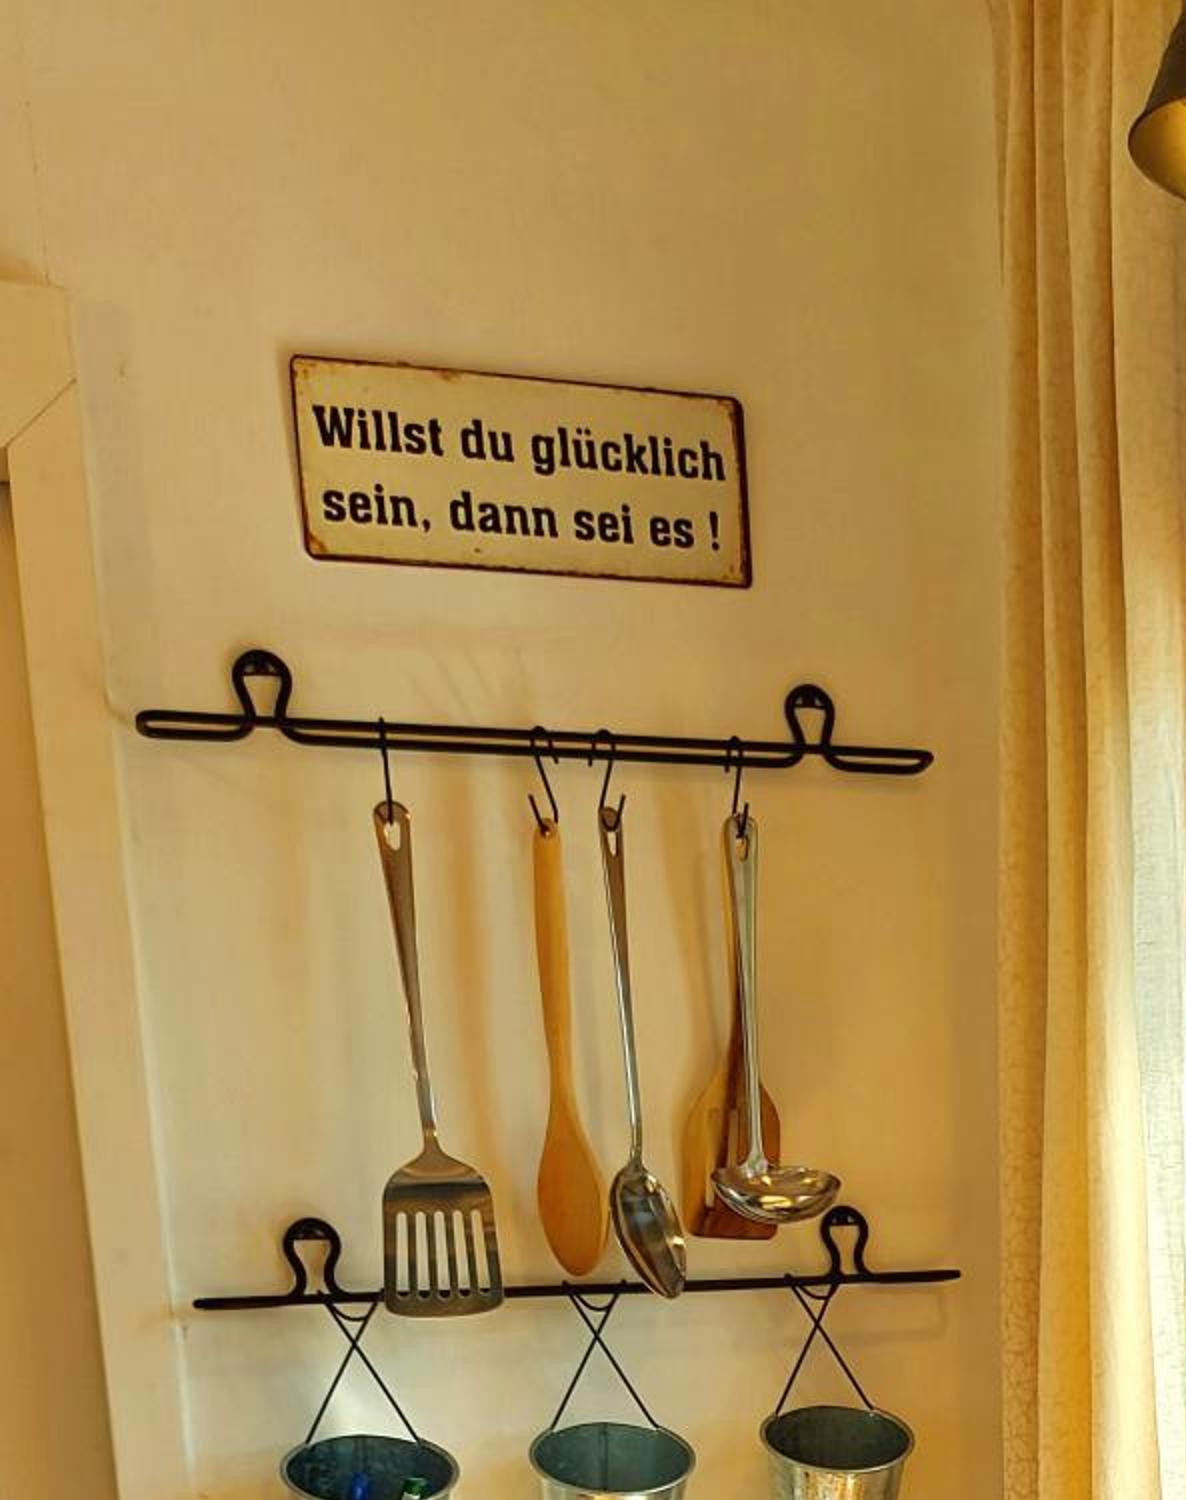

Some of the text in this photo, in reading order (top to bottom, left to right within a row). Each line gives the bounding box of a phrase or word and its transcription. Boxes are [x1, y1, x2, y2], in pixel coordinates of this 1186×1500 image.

[312, 404, 727, 482] Willst du glücklich
[322, 483, 721, 553] sein, dann sei es !
